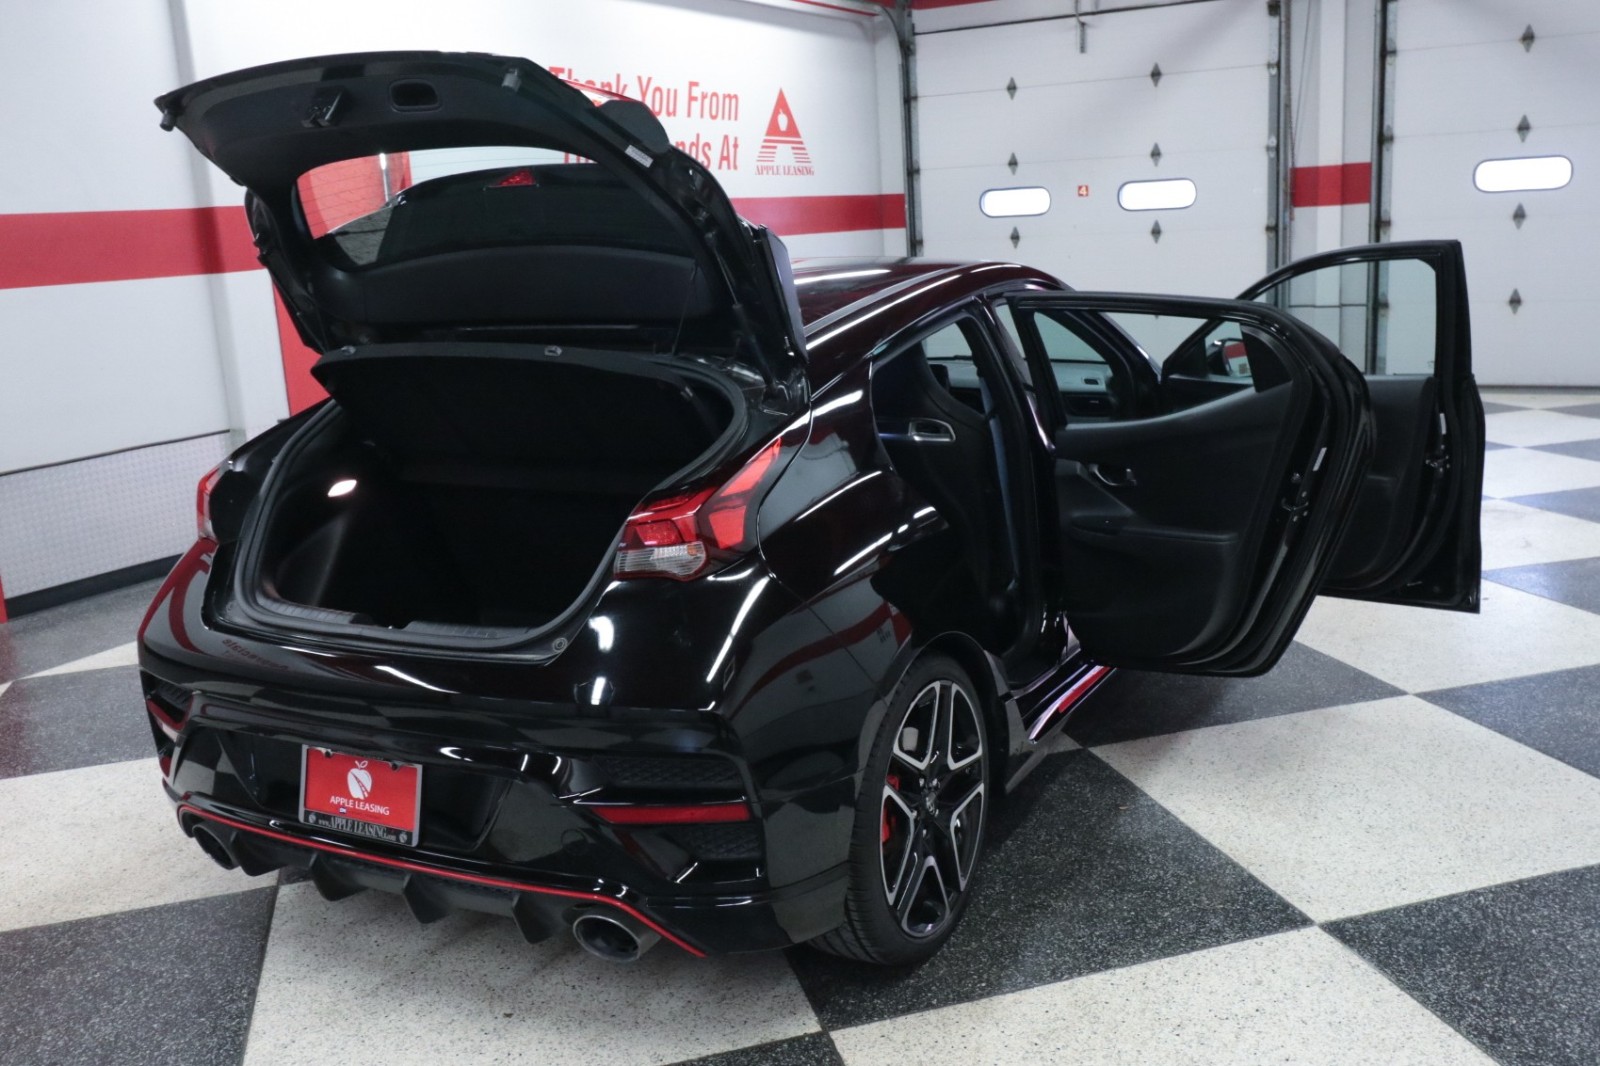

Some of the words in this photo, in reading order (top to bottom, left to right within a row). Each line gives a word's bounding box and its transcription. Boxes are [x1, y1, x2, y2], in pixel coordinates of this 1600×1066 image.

[637, 75, 677, 118] You
[687, 81, 739, 121] From
[718, 134, 739, 171] At
[755, 165, 781, 176] APPLE
[783, 165, 815, 177] LEASING
[330, 795, 354, 808] APPLE
[355, 801, 390, 816] LEASING
